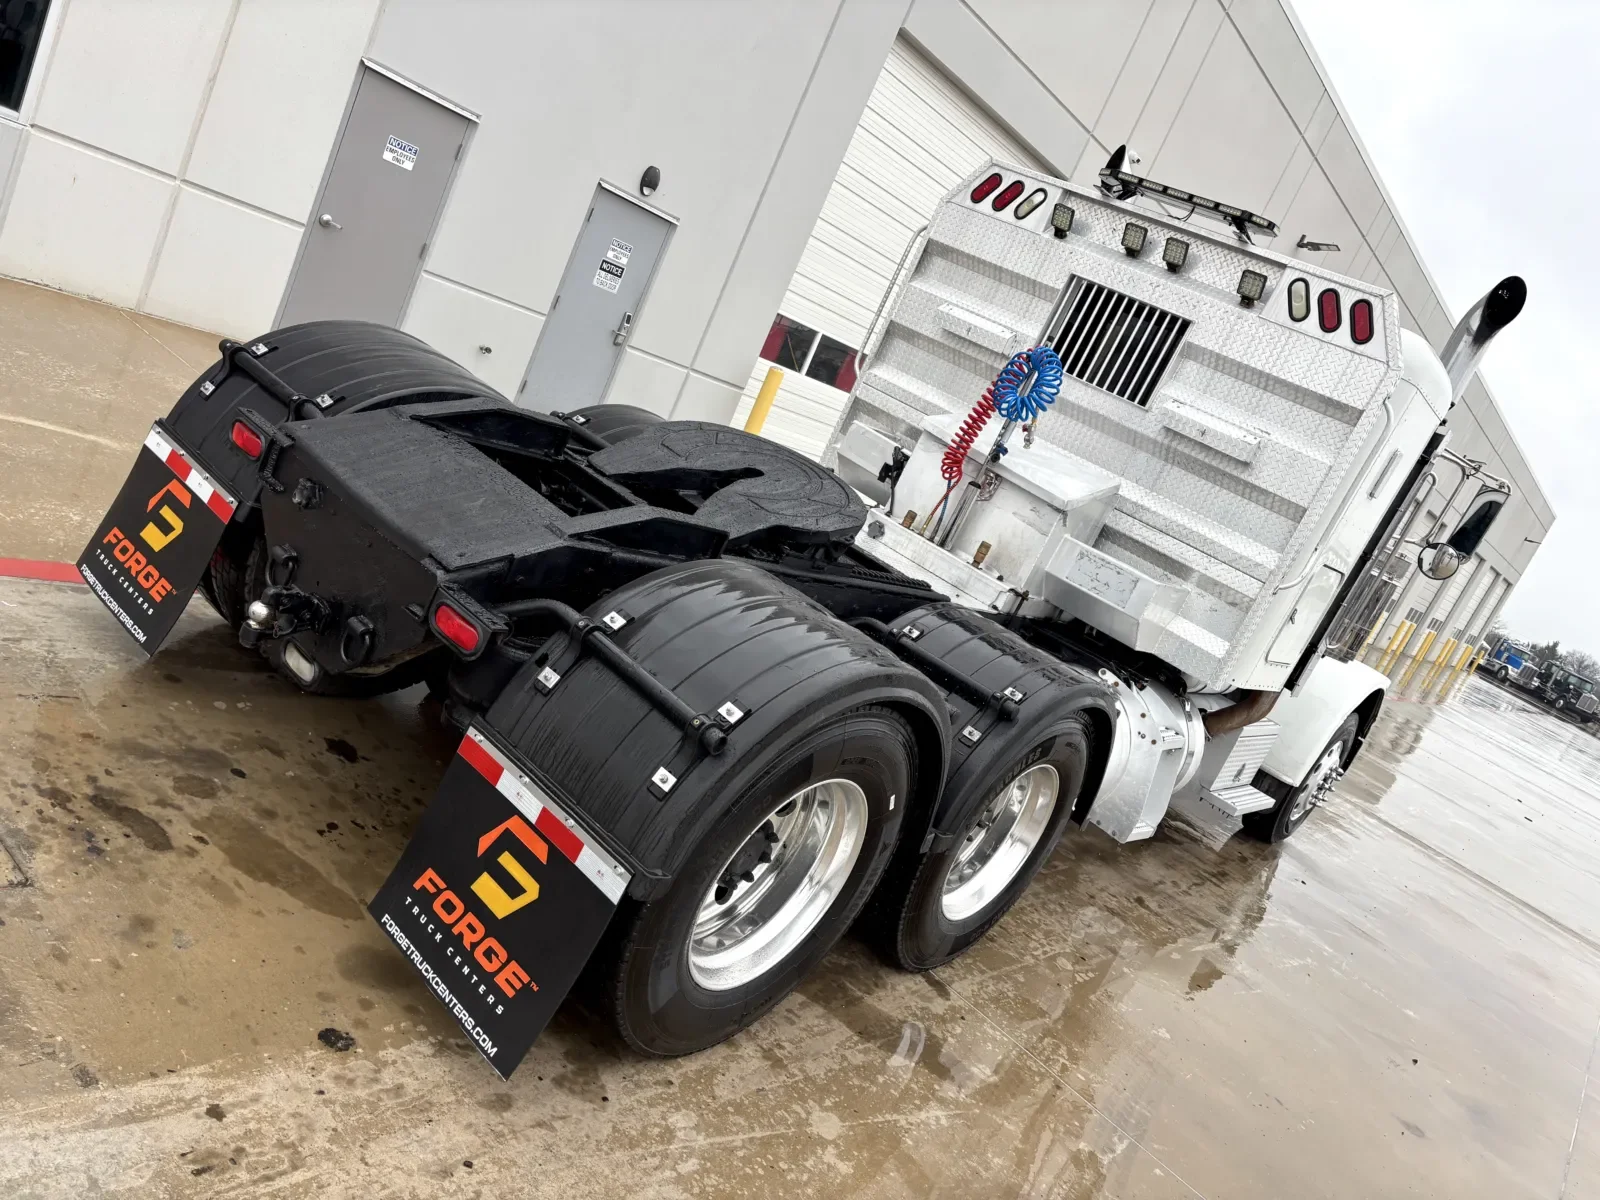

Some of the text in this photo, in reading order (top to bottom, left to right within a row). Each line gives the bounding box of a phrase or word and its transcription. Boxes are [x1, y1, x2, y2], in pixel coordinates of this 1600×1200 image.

[385, 145, 415, 163] EMPLOYEES
[390, 137, 417, 156] NOTICE
[392, 156, 405, 165] ONLY
[601, 261, 623, 276] NOTICE
[611, 238, 632, 253] NOTICE
[96, 549, 153, 615] TRUCK CENTERS
[104, 527, 172, 602] FORGE
[81, 564, 147, 643] FORGETRUCKCENTERS.COM
[406, 897, 504, 1014] TRUCK CENTERS
[413, 868, 530, 998] FORGE
[381, 914, 497, 1057] FORGETRUCKCENTERS.COM
